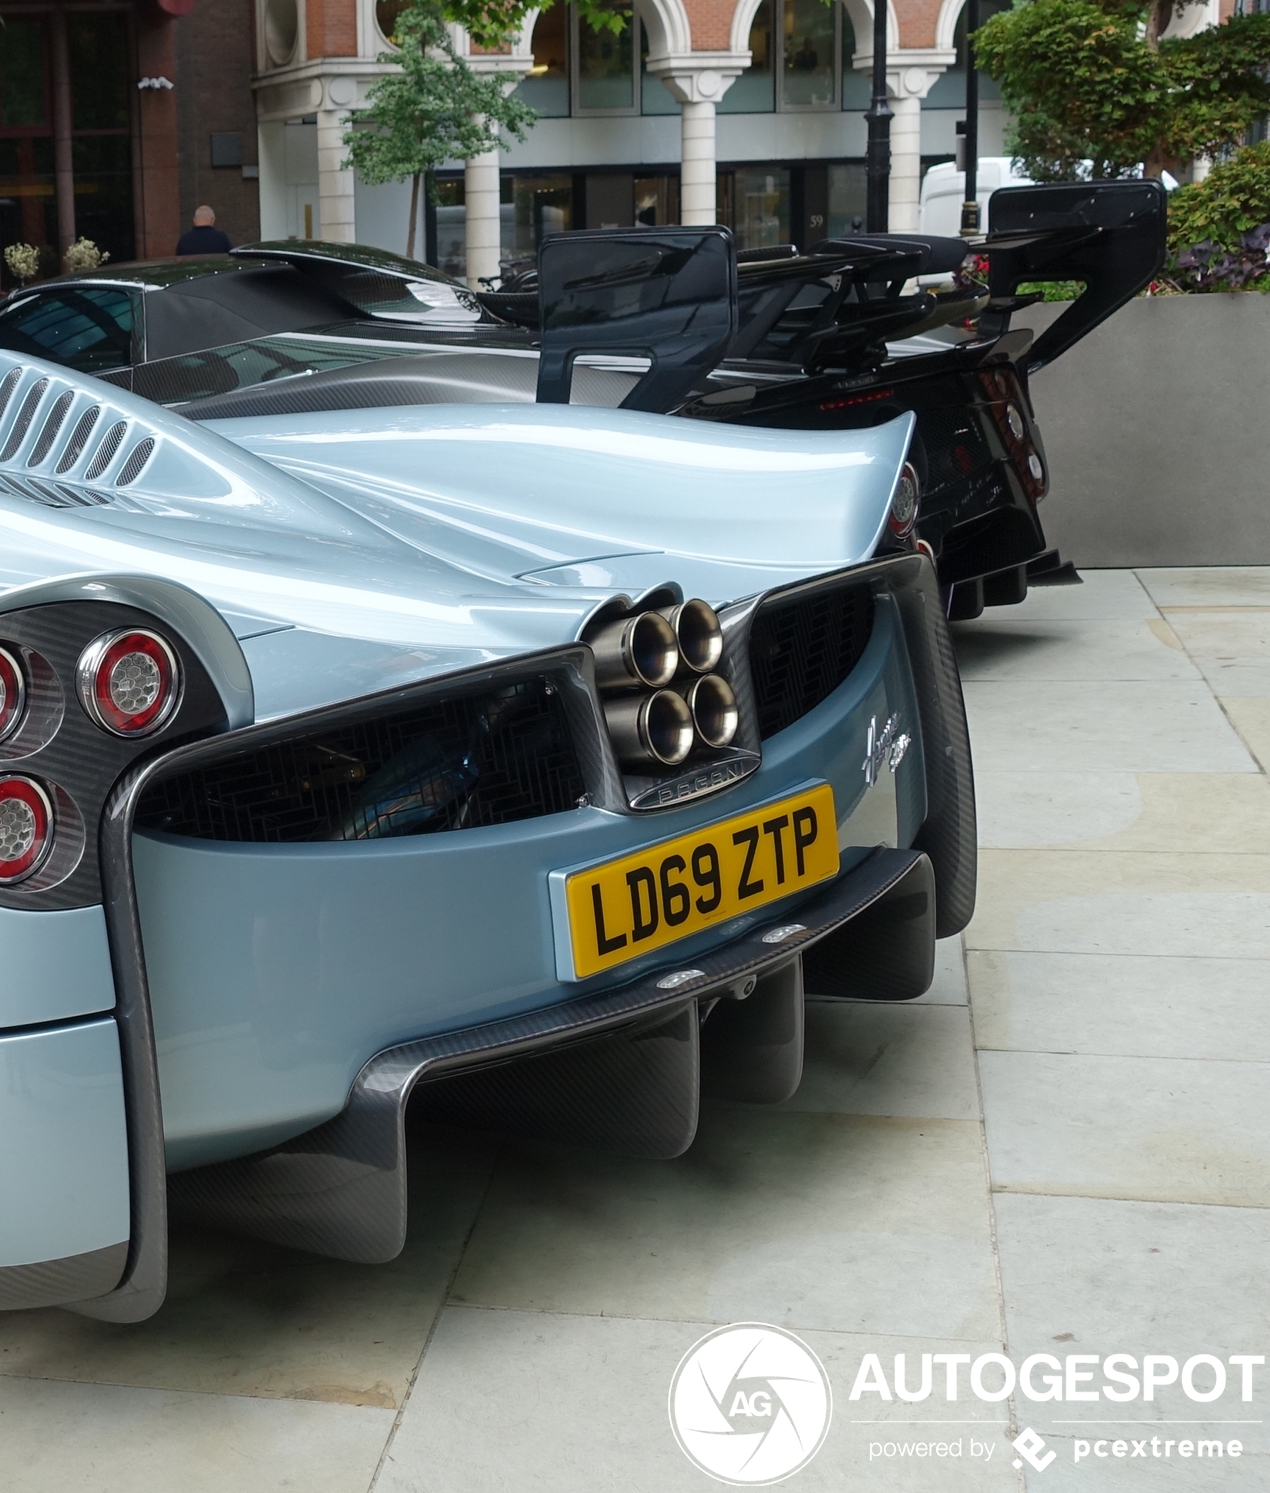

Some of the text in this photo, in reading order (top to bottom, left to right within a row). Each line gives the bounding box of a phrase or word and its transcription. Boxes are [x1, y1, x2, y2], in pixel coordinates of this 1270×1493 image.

[810, 215, 824, 228] 59
[658, 761, 745, 804] PAGANI
[591, 805, 819, 956] LD69 ZTP
